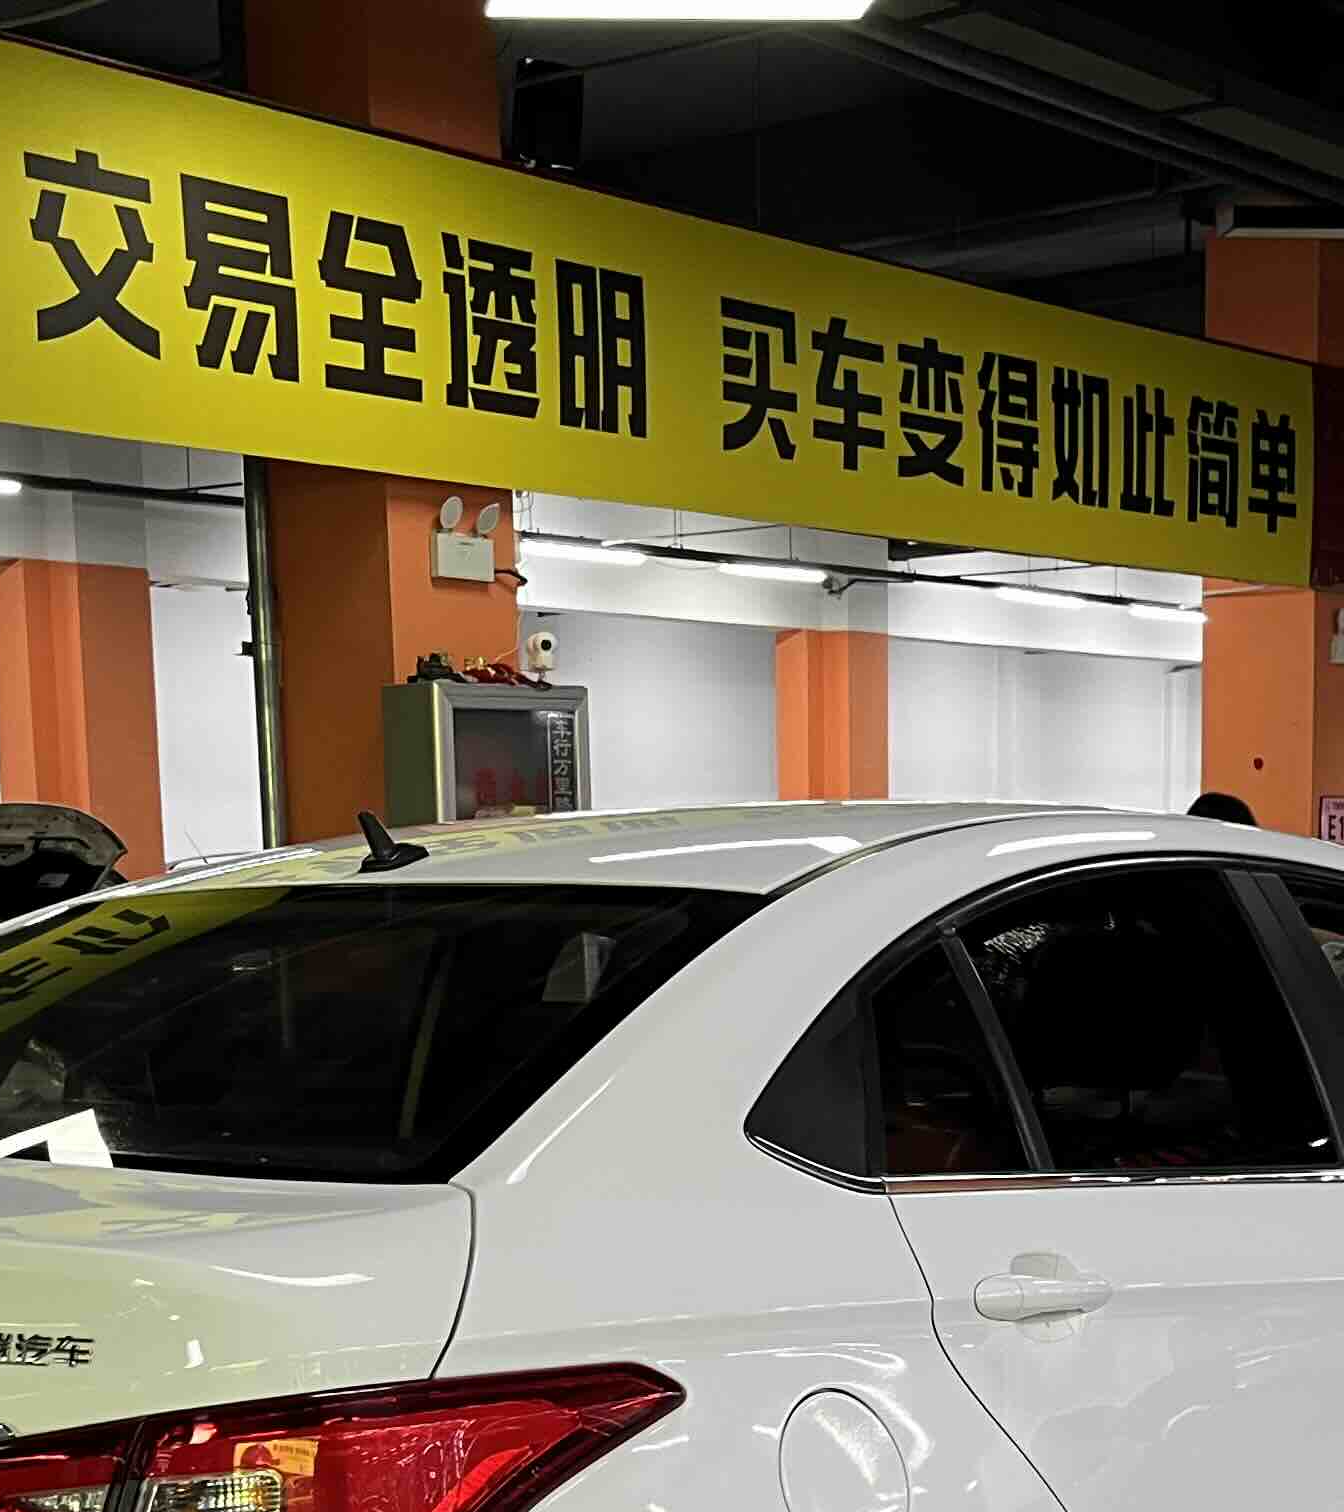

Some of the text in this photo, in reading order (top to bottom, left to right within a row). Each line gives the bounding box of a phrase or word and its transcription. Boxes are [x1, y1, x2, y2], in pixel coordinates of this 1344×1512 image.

[23, 148, 648, 439] 交易全透明
[720, 296, 1297, 533] 买车变得如此简单
